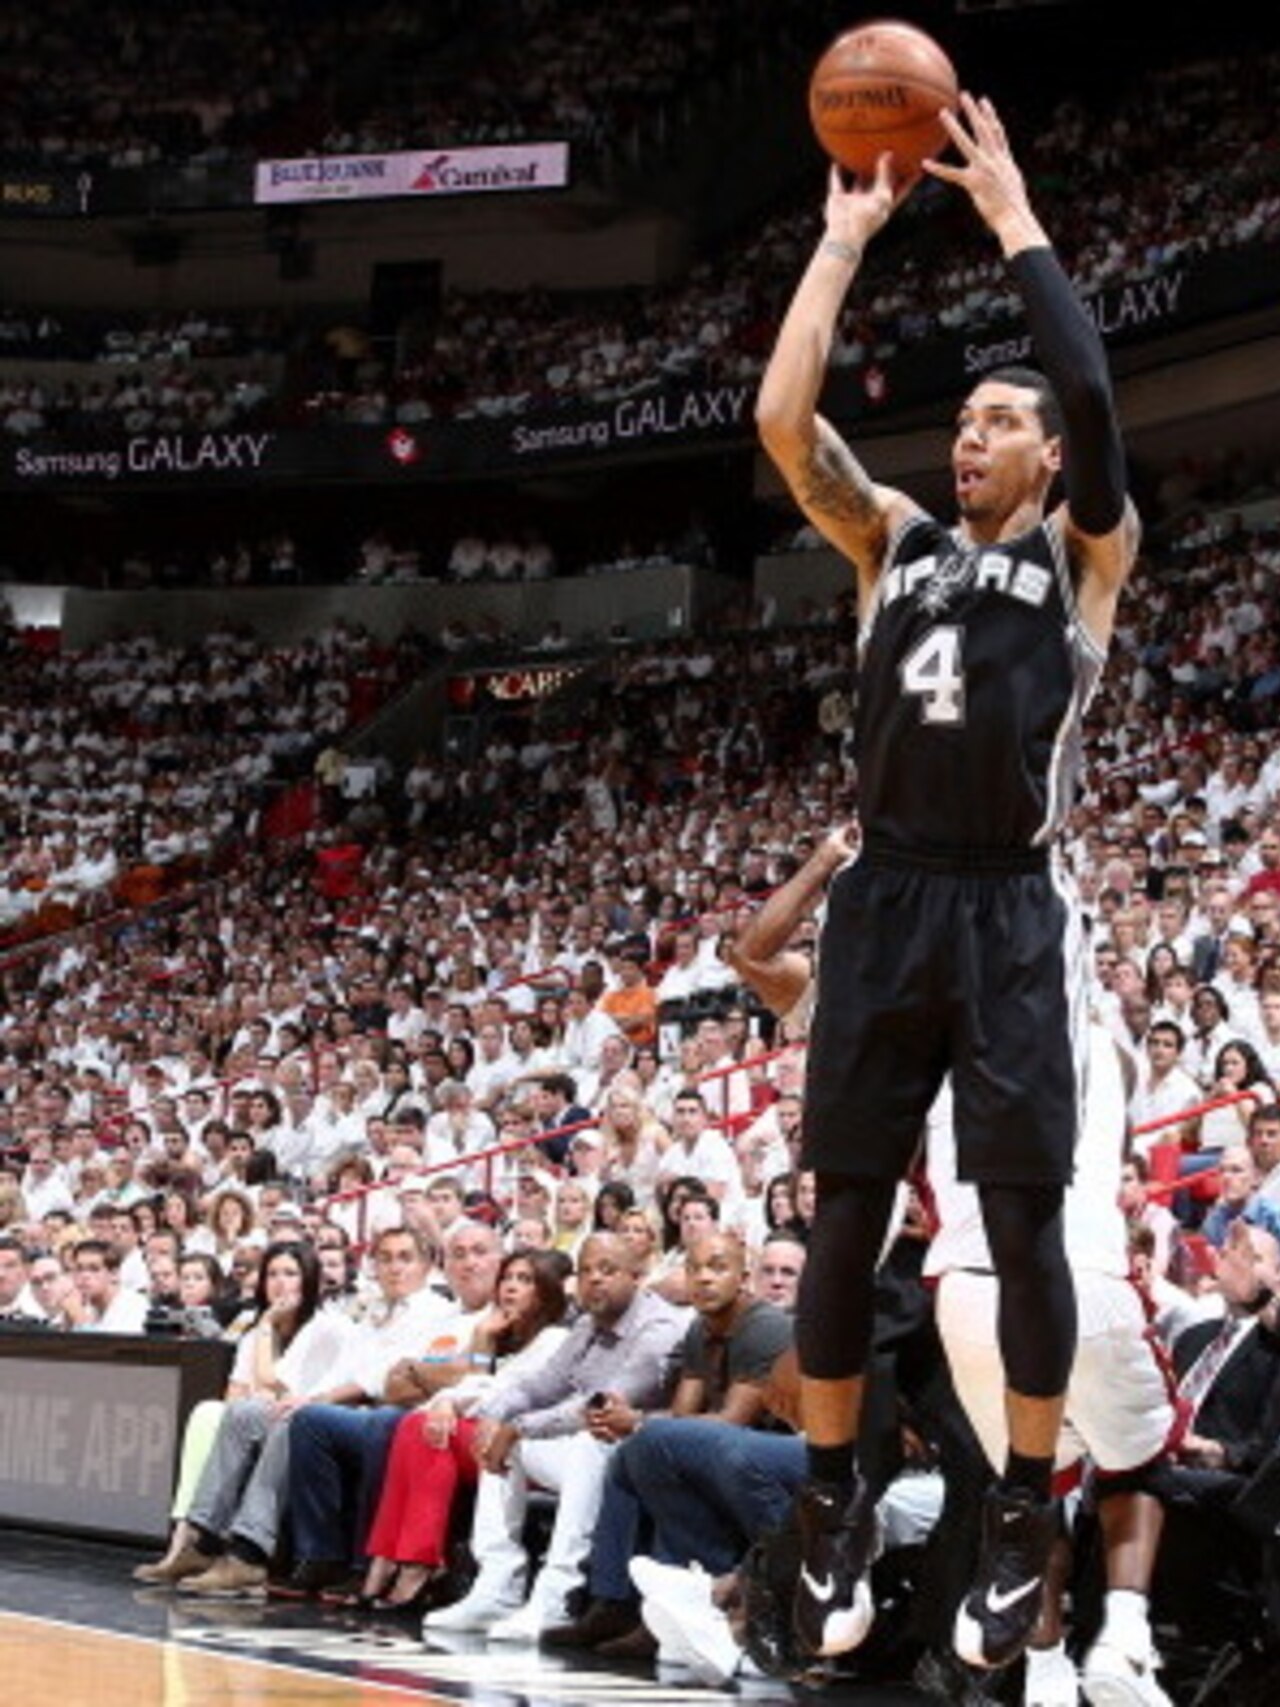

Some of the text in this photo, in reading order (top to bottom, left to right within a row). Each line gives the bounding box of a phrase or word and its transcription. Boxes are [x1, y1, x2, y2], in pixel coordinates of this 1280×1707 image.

[15, 434, 268, 480] Samsung GALAXY
[511, 386, 748, 454] Samsung GALAXY
[900, 624, 966, 725] 4
[76, 1401, 170, 1498] APP
